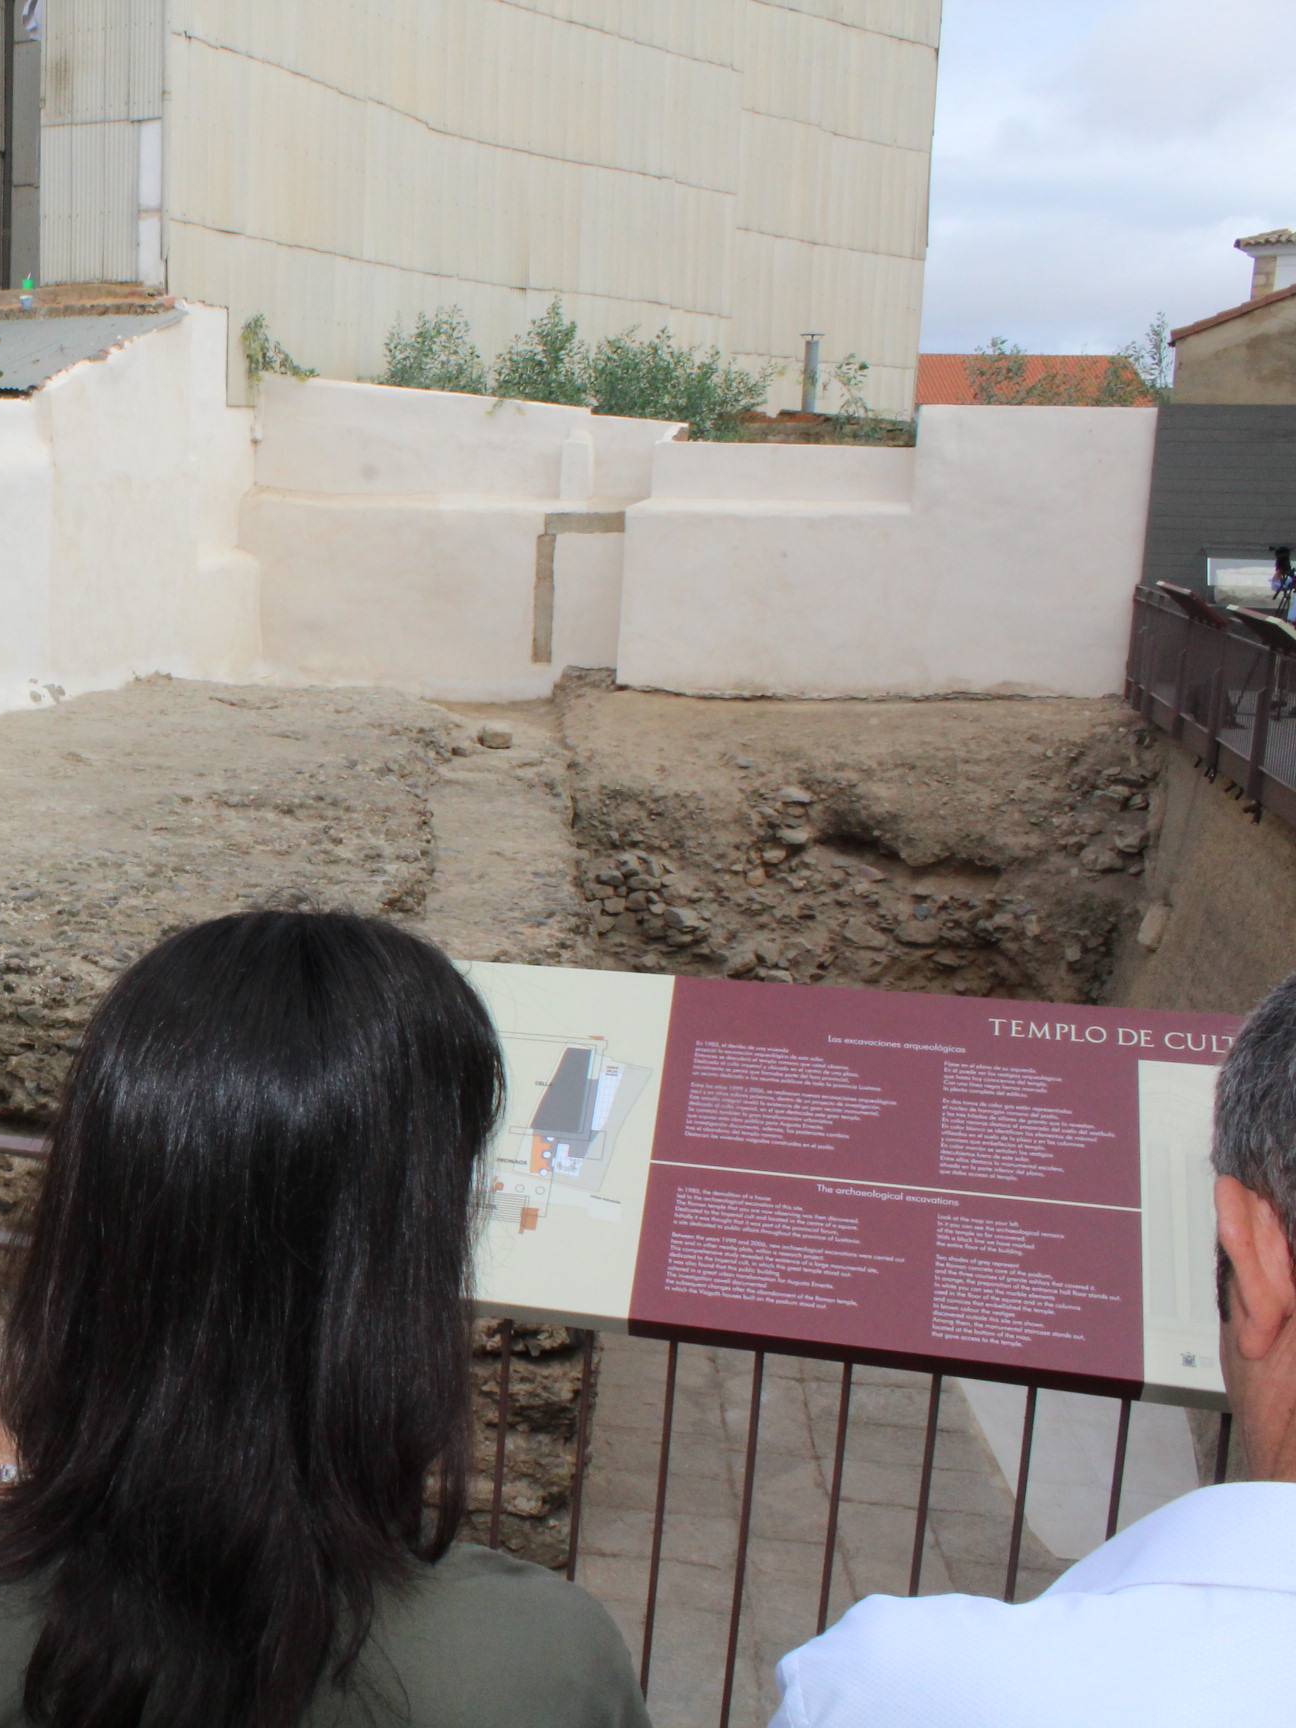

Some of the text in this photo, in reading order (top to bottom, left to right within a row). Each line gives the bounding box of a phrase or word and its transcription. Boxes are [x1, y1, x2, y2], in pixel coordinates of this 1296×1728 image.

[828, 1034, 966, 1054] Las excavaciones arqueológicas
[989, 1018, 1107, 1043] TEMPLO
[1117, 1027, 1154, 1048] DE
[816, 1184, 959, 1206] The archaeological excavations
